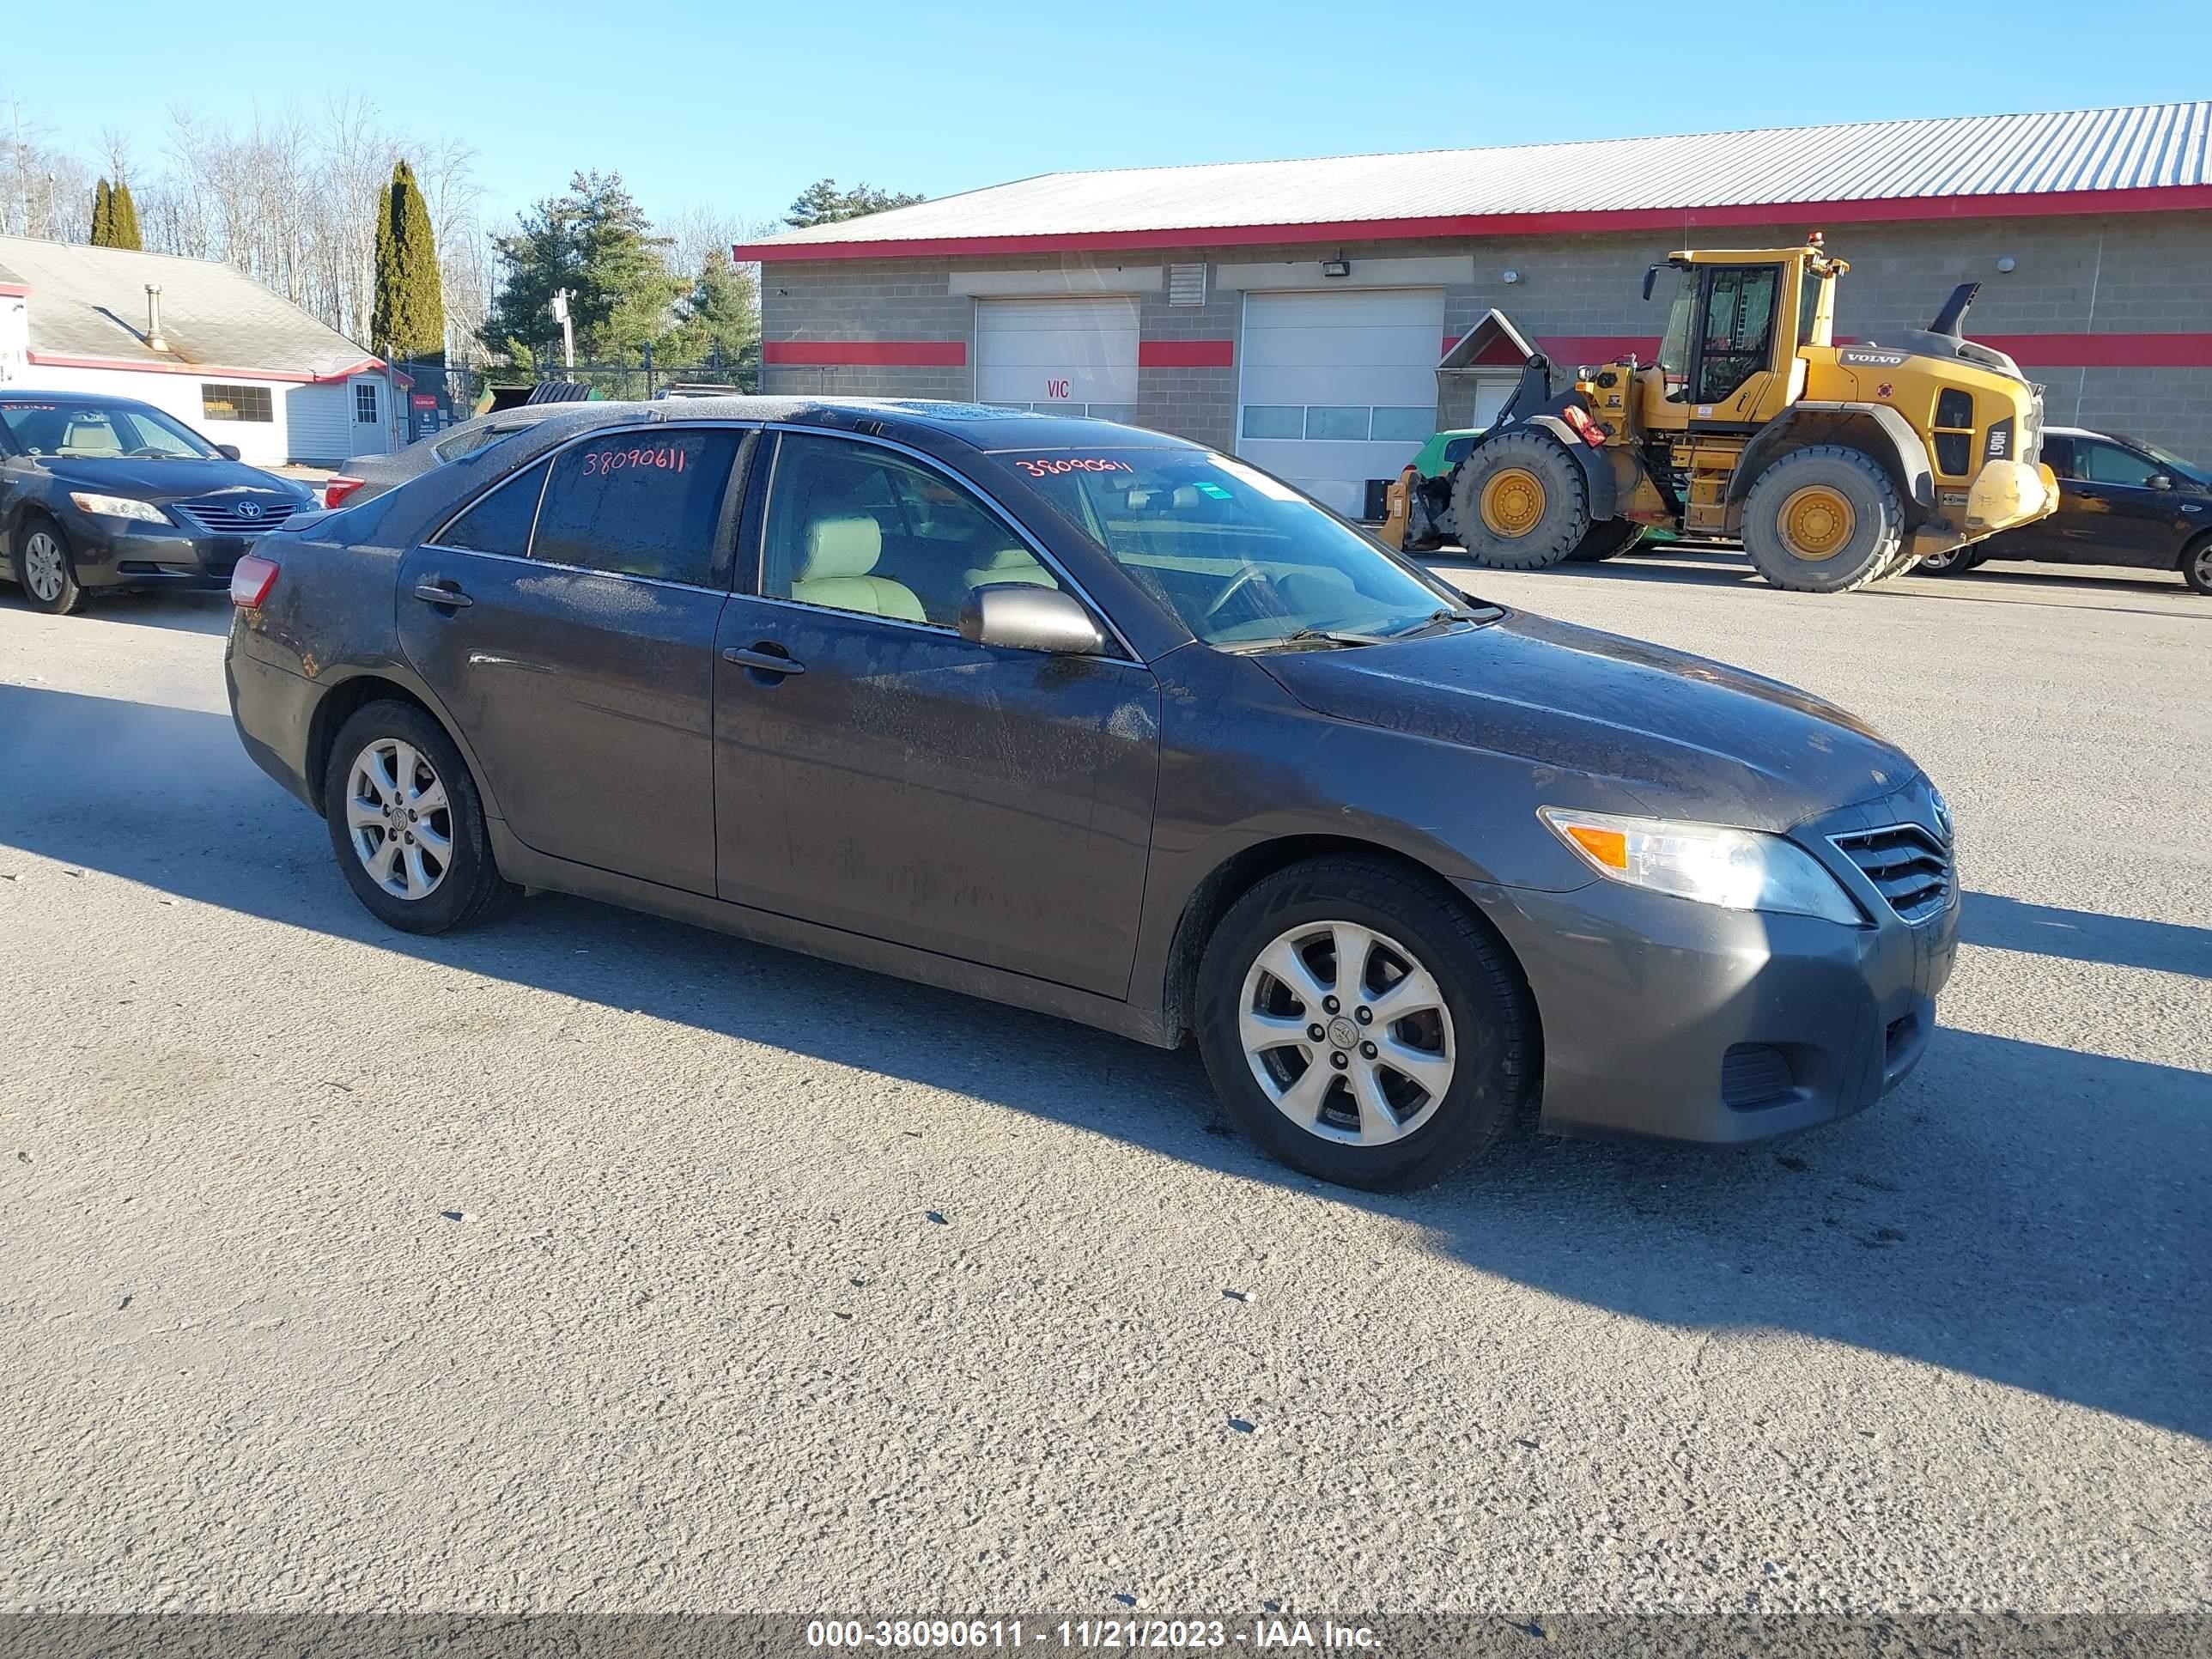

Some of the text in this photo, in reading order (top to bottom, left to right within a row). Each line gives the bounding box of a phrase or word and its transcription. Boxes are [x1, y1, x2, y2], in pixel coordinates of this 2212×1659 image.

[1847, 353, 1902, 365] VOLVO
[1048, 380, 1069, 398] VIC
[1988, 431, 2007, 456] L90H
[582, 448, 685, 476] 38090611
